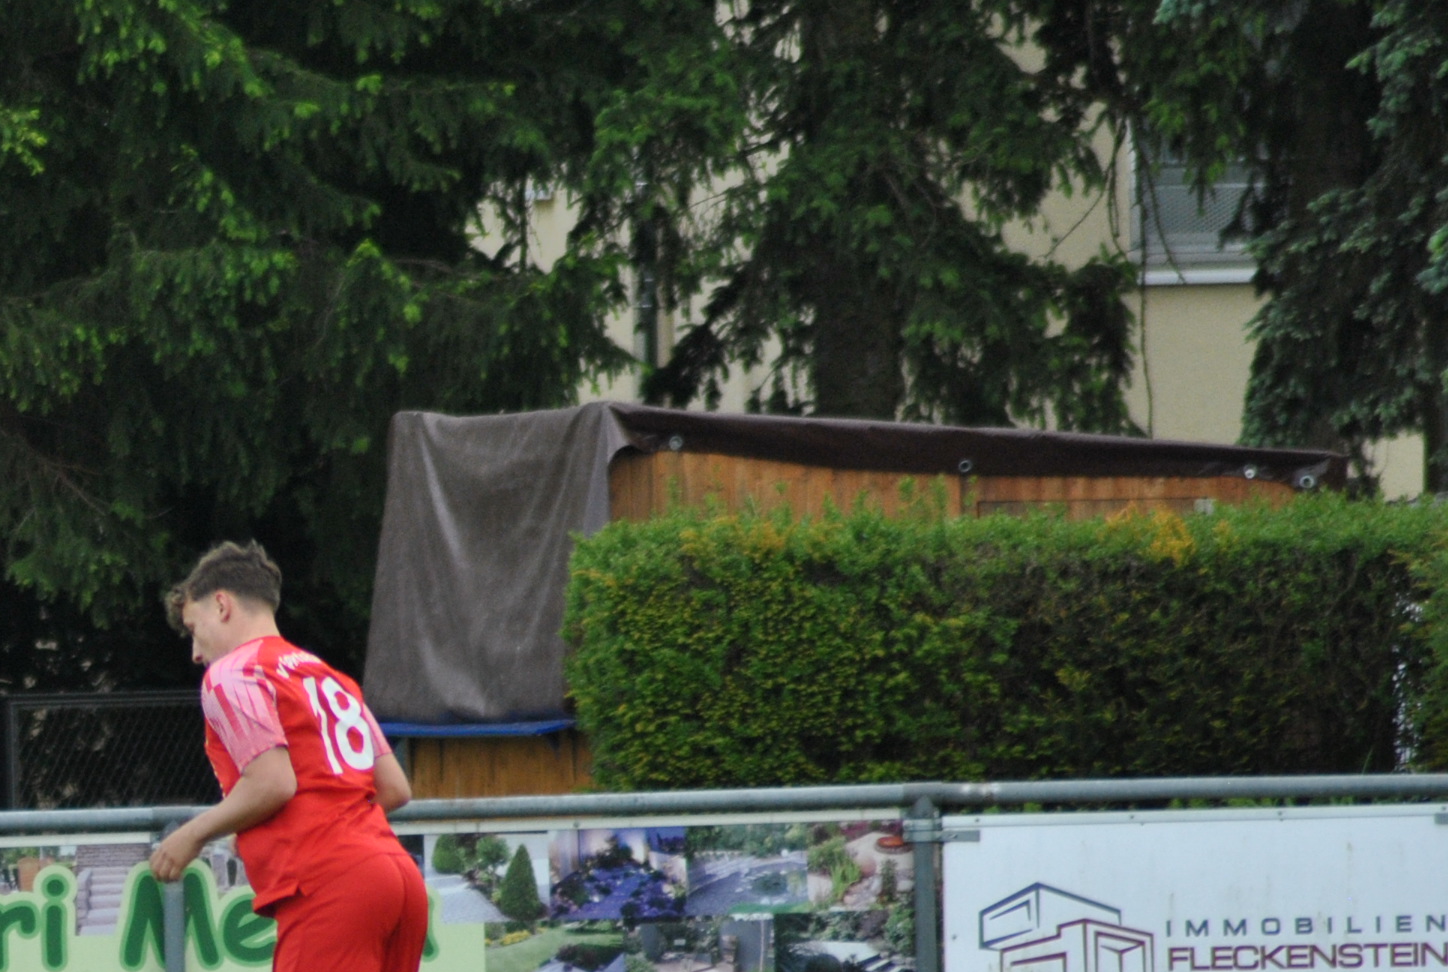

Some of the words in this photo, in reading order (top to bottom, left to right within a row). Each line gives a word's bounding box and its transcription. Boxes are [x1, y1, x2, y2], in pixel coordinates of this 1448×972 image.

[302, 675, 375, 775] 18
[1165, 914, 1447, 938] IMMOBILIEN
[1167, 941, 1448, 972] FLECKENSTEIN
